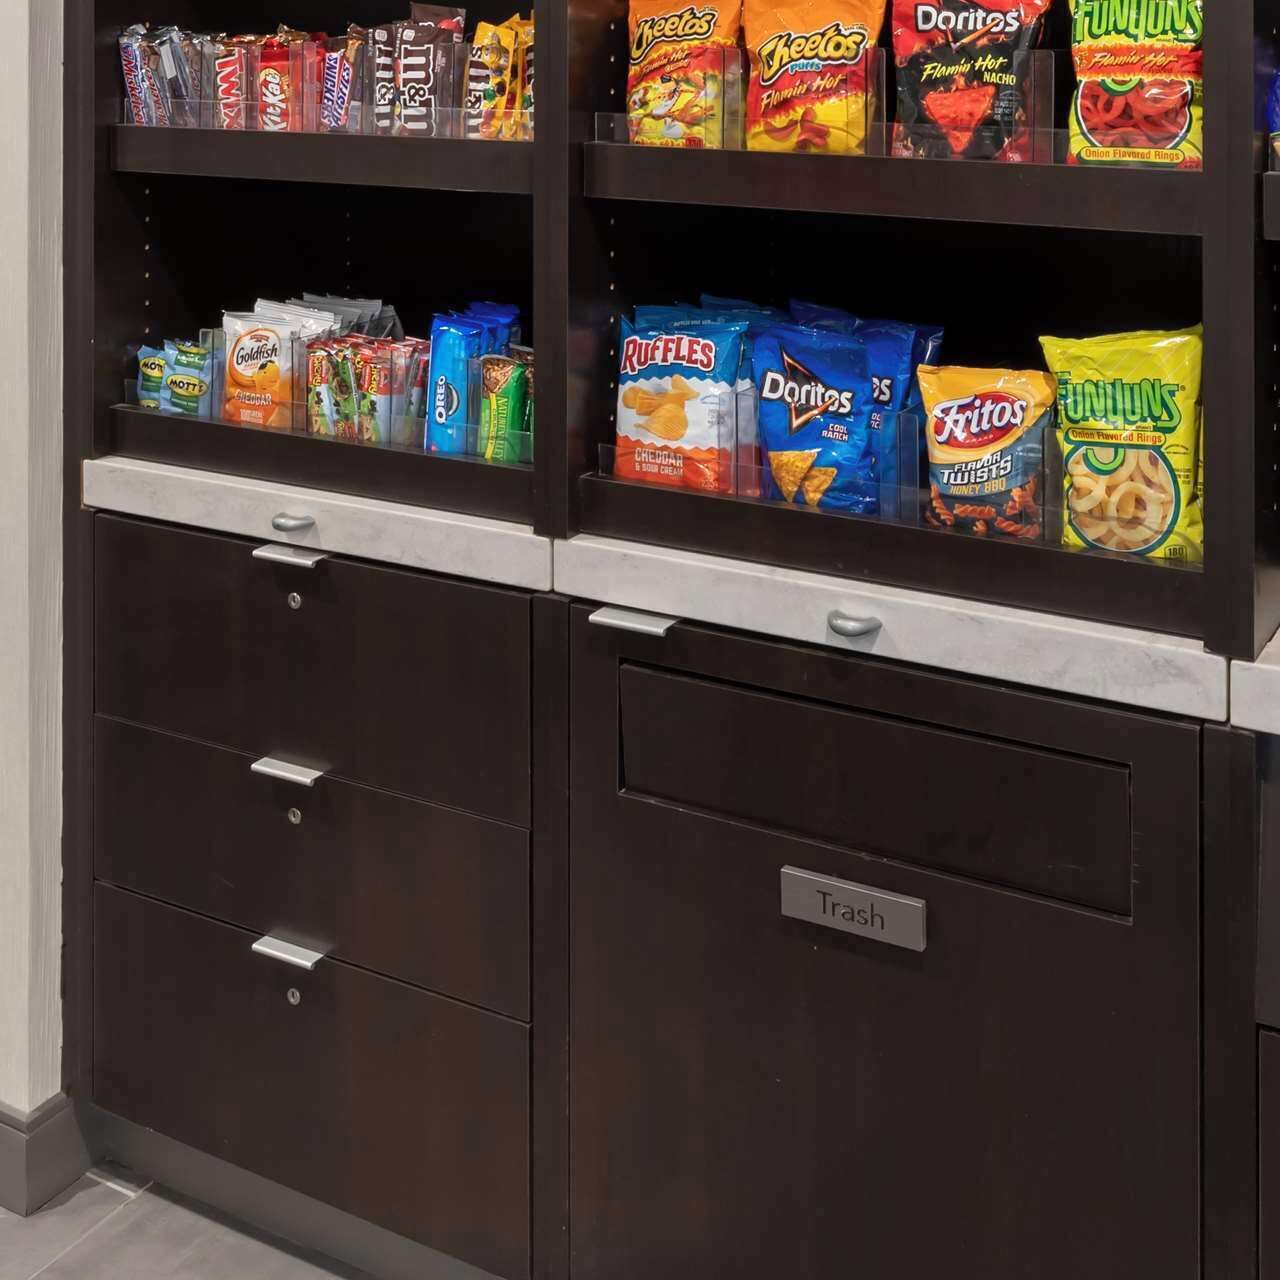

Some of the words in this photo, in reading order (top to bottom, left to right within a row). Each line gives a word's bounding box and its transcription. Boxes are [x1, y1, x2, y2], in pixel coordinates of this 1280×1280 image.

[917, 5, 1020, 33] Doritos
[631, 6, 717, 62] Cheetos
[759, 23, 867, 83] Cheetos
[1145, 52, 1178, 68] Hot
[920, 58, 972, 82] Flamin'
[975, 53, 1008, 71] Hot
[983, 71, 1016, 85] NACHO
[812, 73, 847, 92] Hot
[1085, 148, 1110, 158] Onion
[1113, 150, 1151, 160] Flavored
[1154, 150, 1180, 161] Rings
[236, 343, 278, 366] Goldfish
[621, 336, 715, 374] RUFFLES
[436, 375, 447, 424] OREO
[762, 371, 853, 413] Doritos
[933, 396, 1027, 443] Fritos
[822, 430, 849, 441] RANCH
[1071, 429, 1095, 438] Onion
[1096, 431, 1134, 441] Flavored
[1136, 433, 1162, 443] Rings
[634, 447, 684, 466] CHEDDAR
[954, 451, 1002, 472] FLAVOR
[941, 455, 1014, 484] TWISTS
[950, 485, 981, 495] HONEY
[984, 478, 1006, 493] BBQ
[816, 889, 885, 930] Trash
